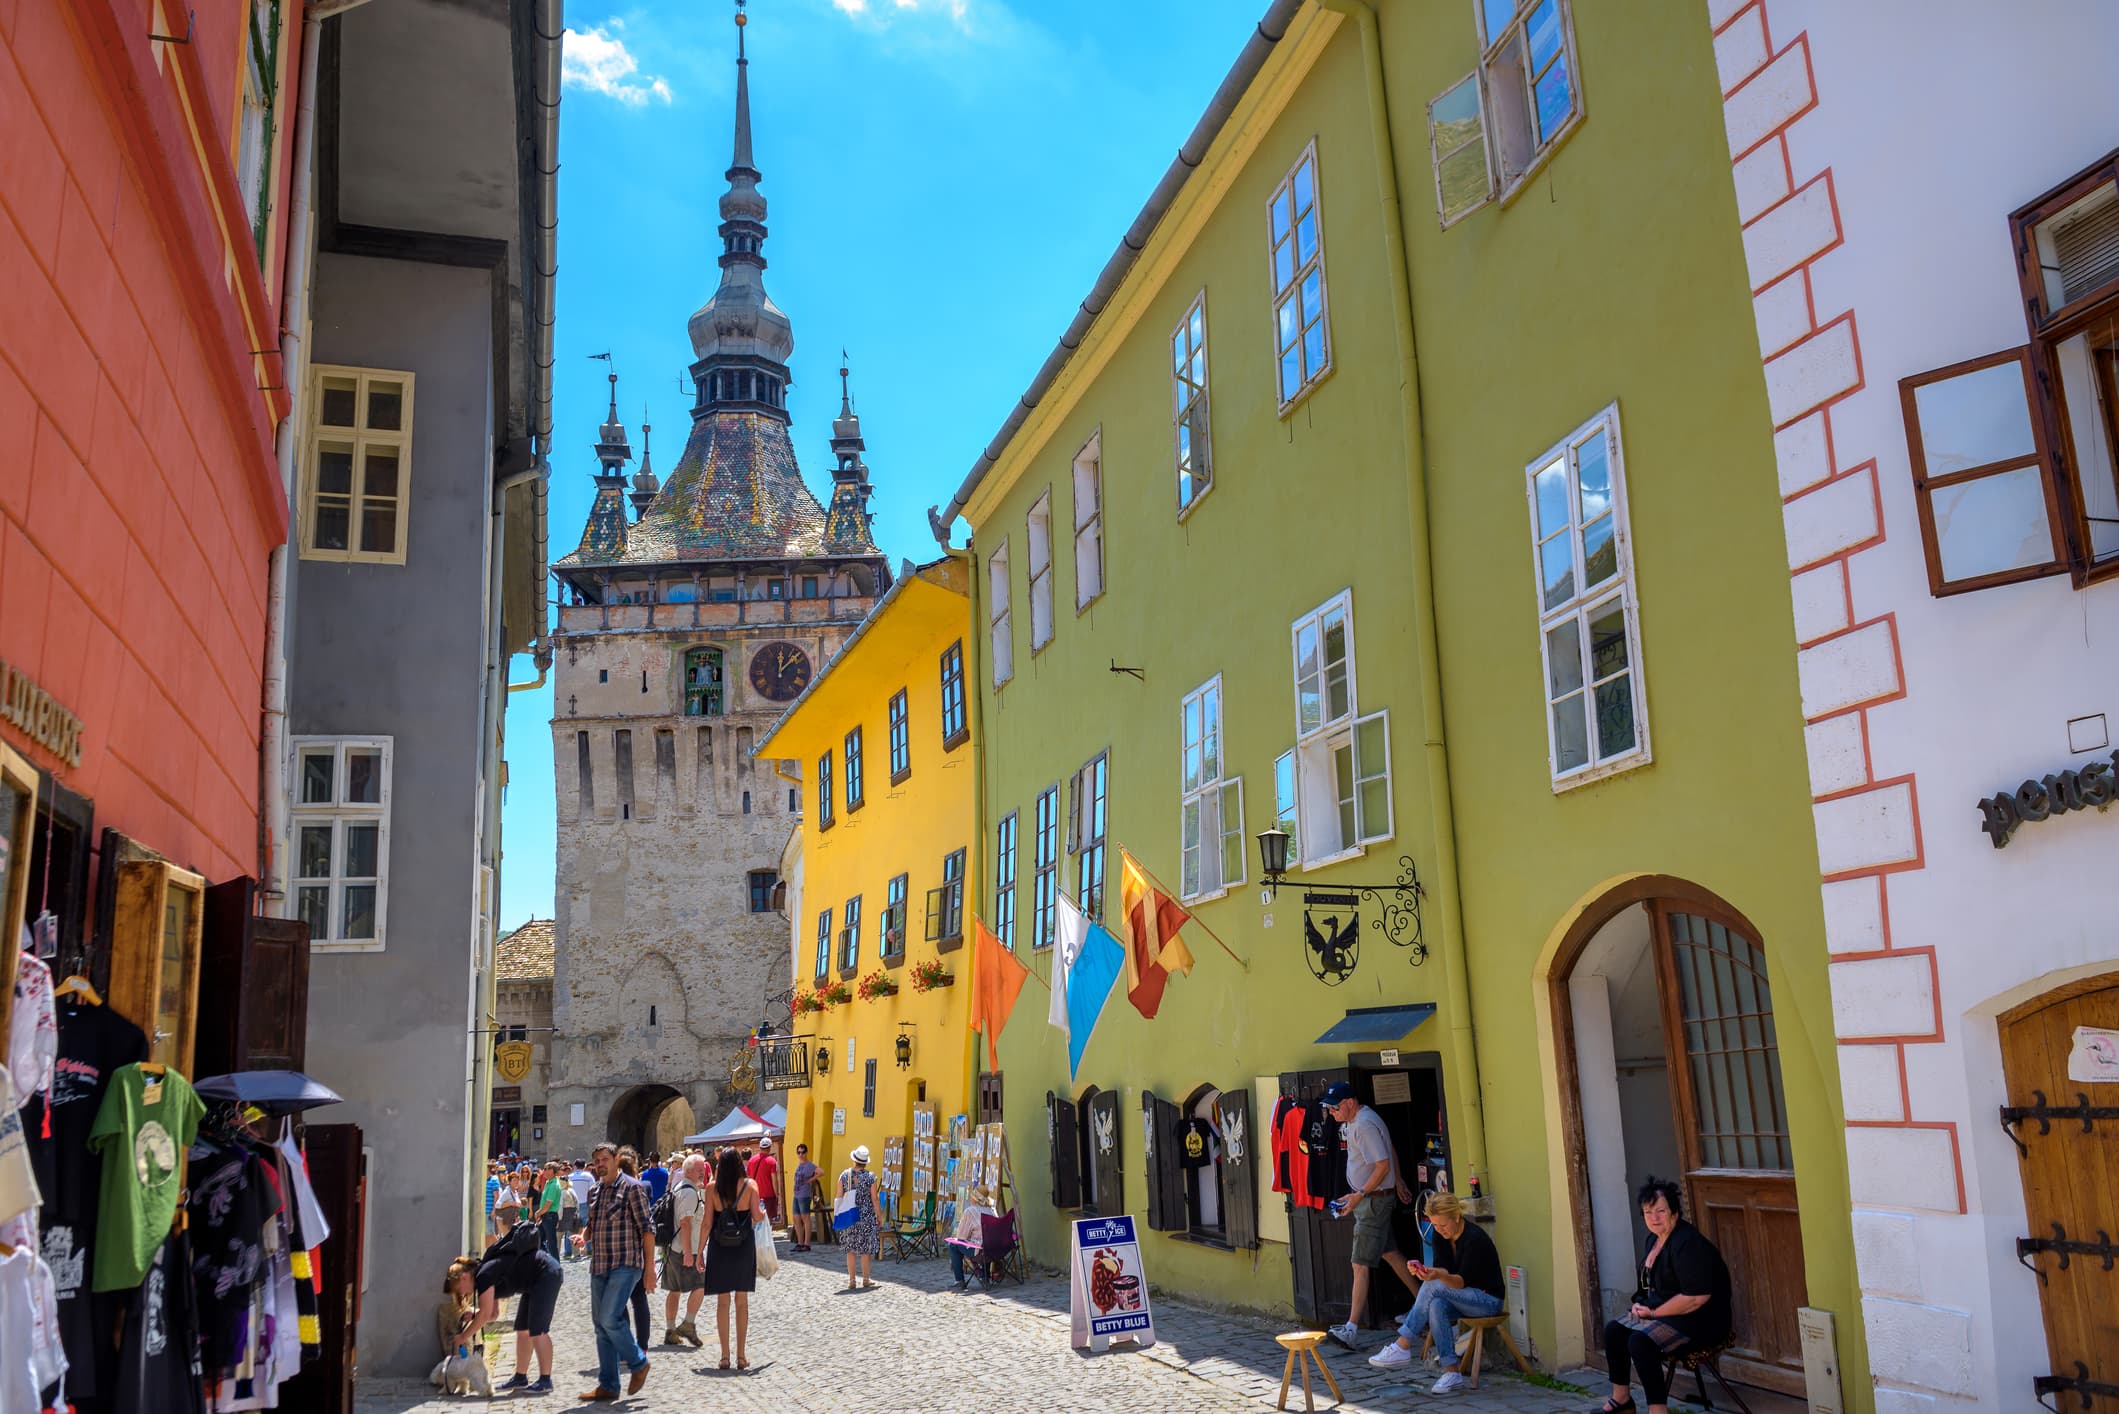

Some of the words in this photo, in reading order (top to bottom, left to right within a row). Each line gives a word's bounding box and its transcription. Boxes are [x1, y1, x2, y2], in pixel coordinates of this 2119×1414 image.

[1088, 1229, 1107, 1238] BETTY
[1114, 1226, 1124, 1235] ICE
[1096, 1319, 1122, 1332] BETTY
[1124, 1316, 1147, 1329] BLUE
